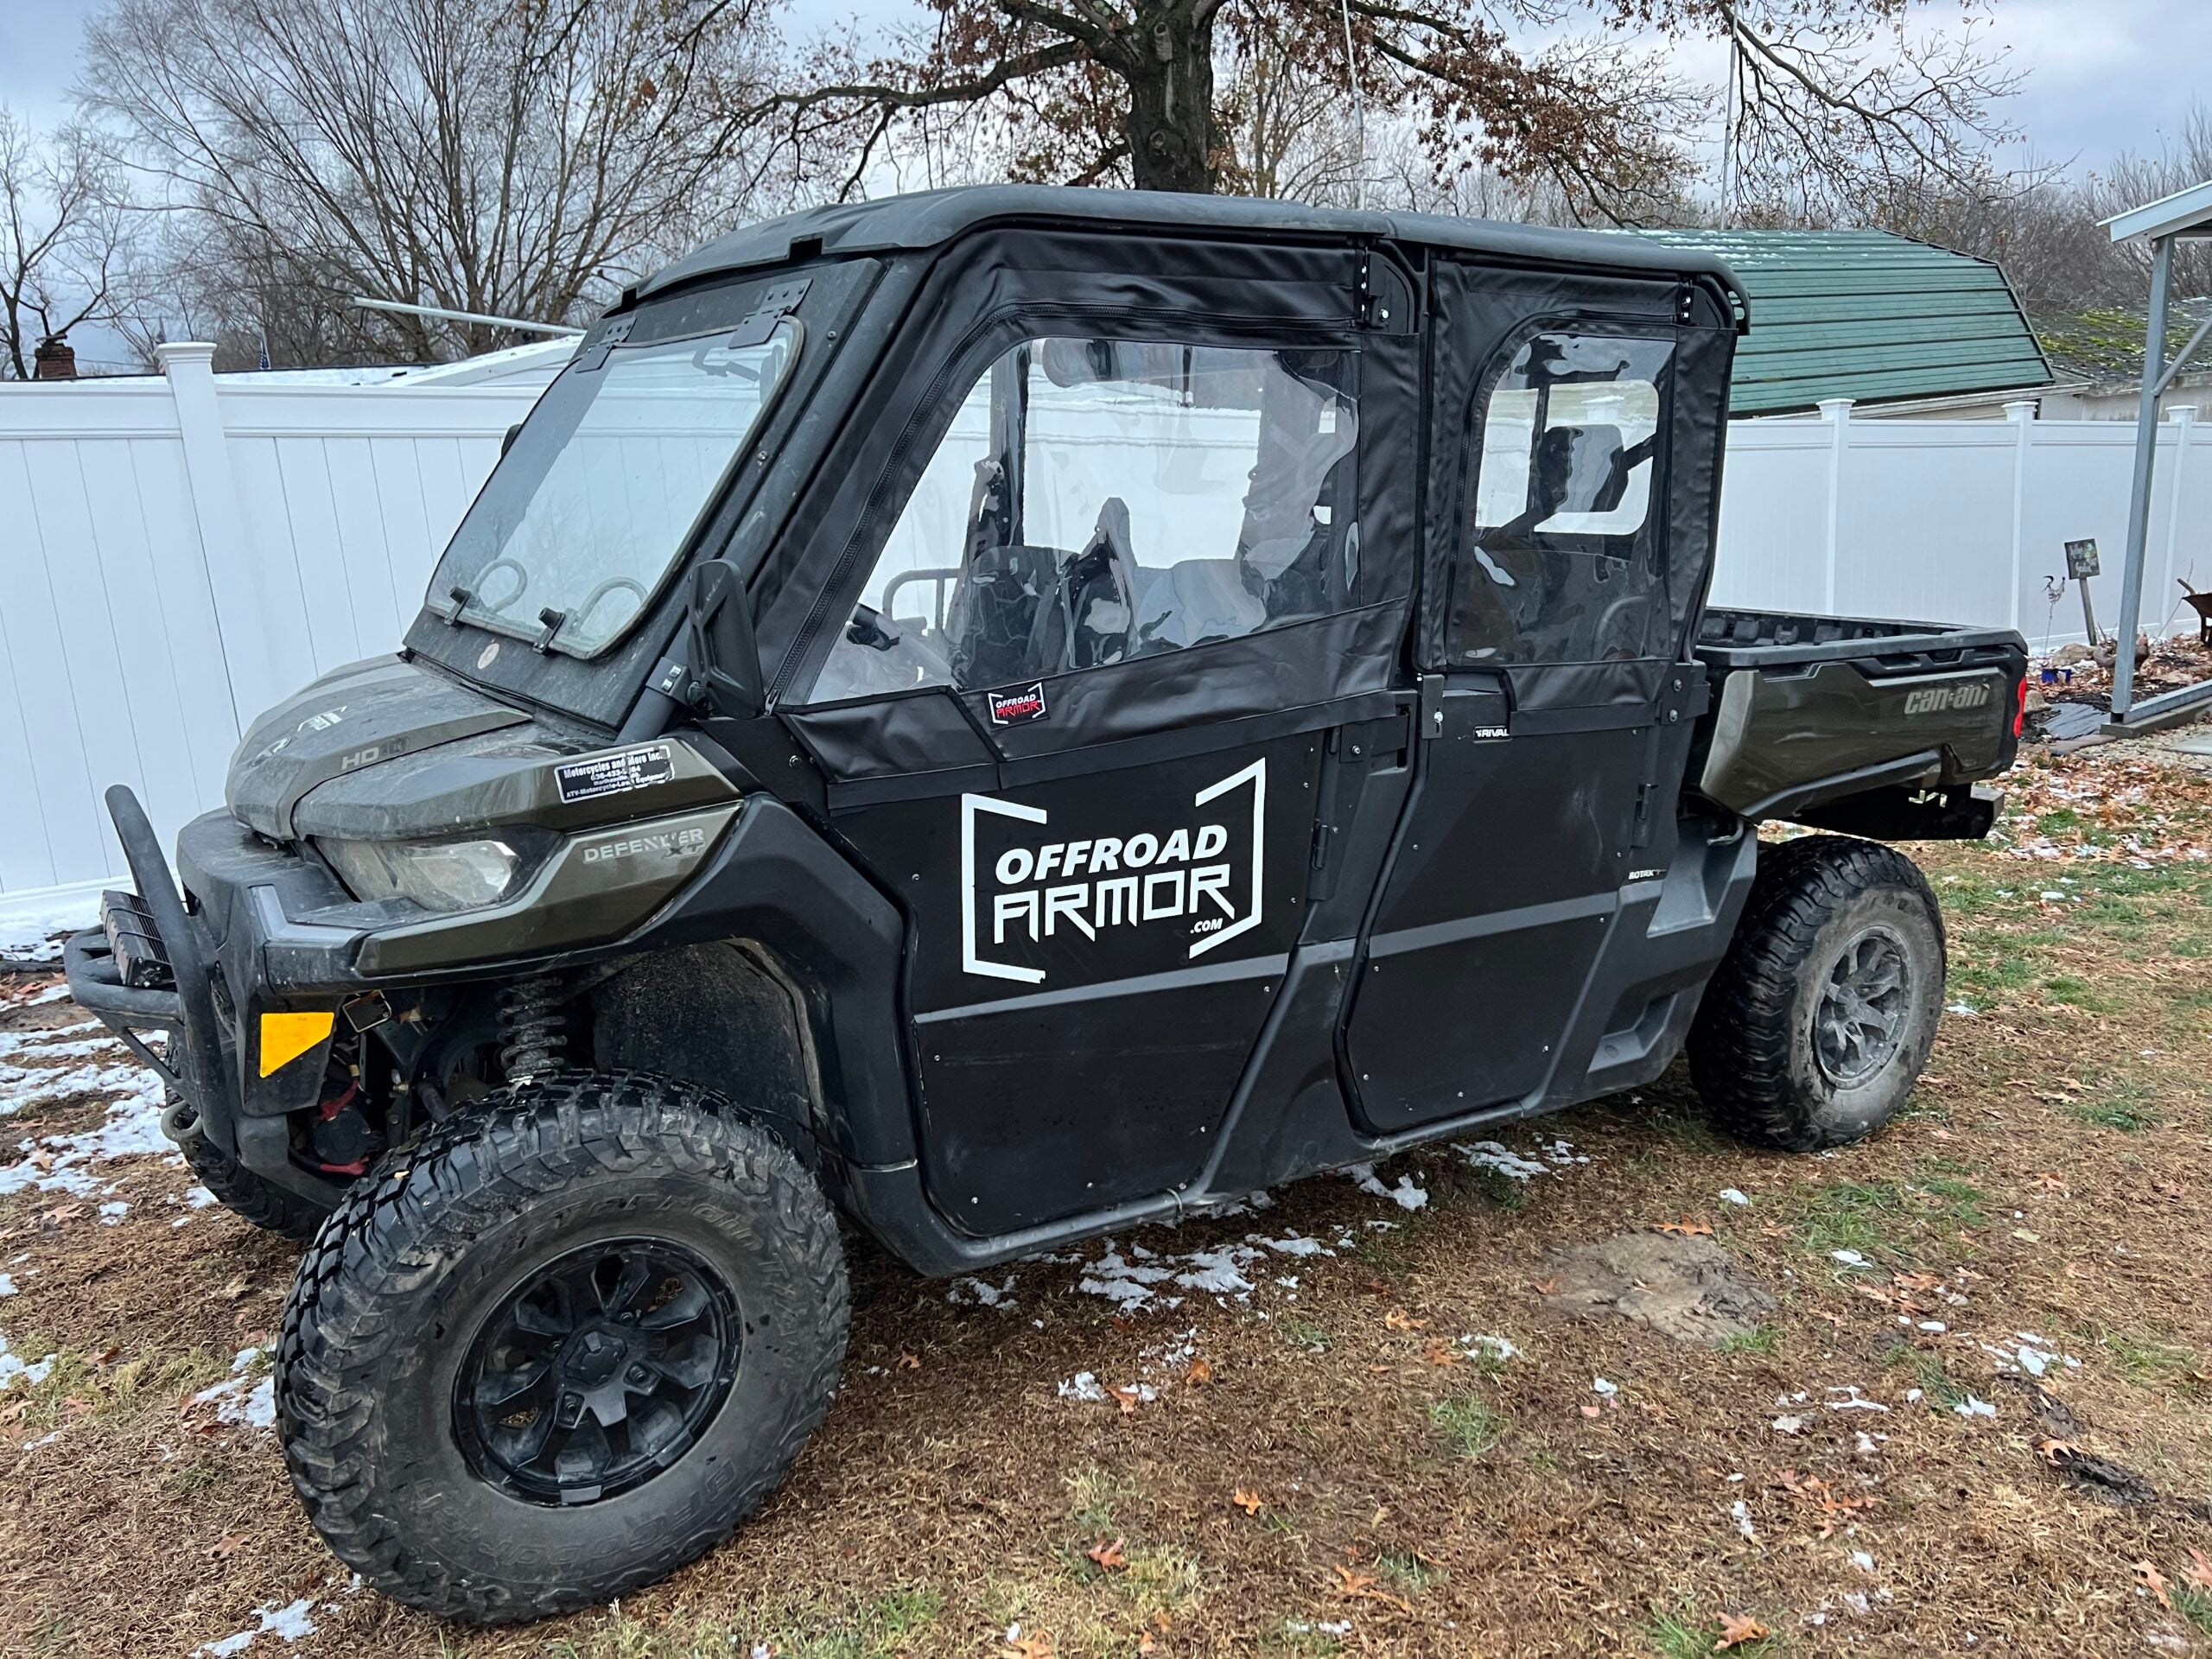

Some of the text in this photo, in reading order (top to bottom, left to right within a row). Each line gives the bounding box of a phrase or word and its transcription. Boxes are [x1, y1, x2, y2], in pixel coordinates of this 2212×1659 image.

[995, 694, 1037, 709] OFFROAD
[996, 701, 1041, 719] ARMOR
[563, 761, 610, 779] Motorcycles
[611, 758, 626, 770] and
[647, 751, 663, 761] Inc.
[995, 824, 1228, 885] OFFROAD
[994, 864, 1235, 944] ARMOR
[1190, 918, 1223, 934] .COM
